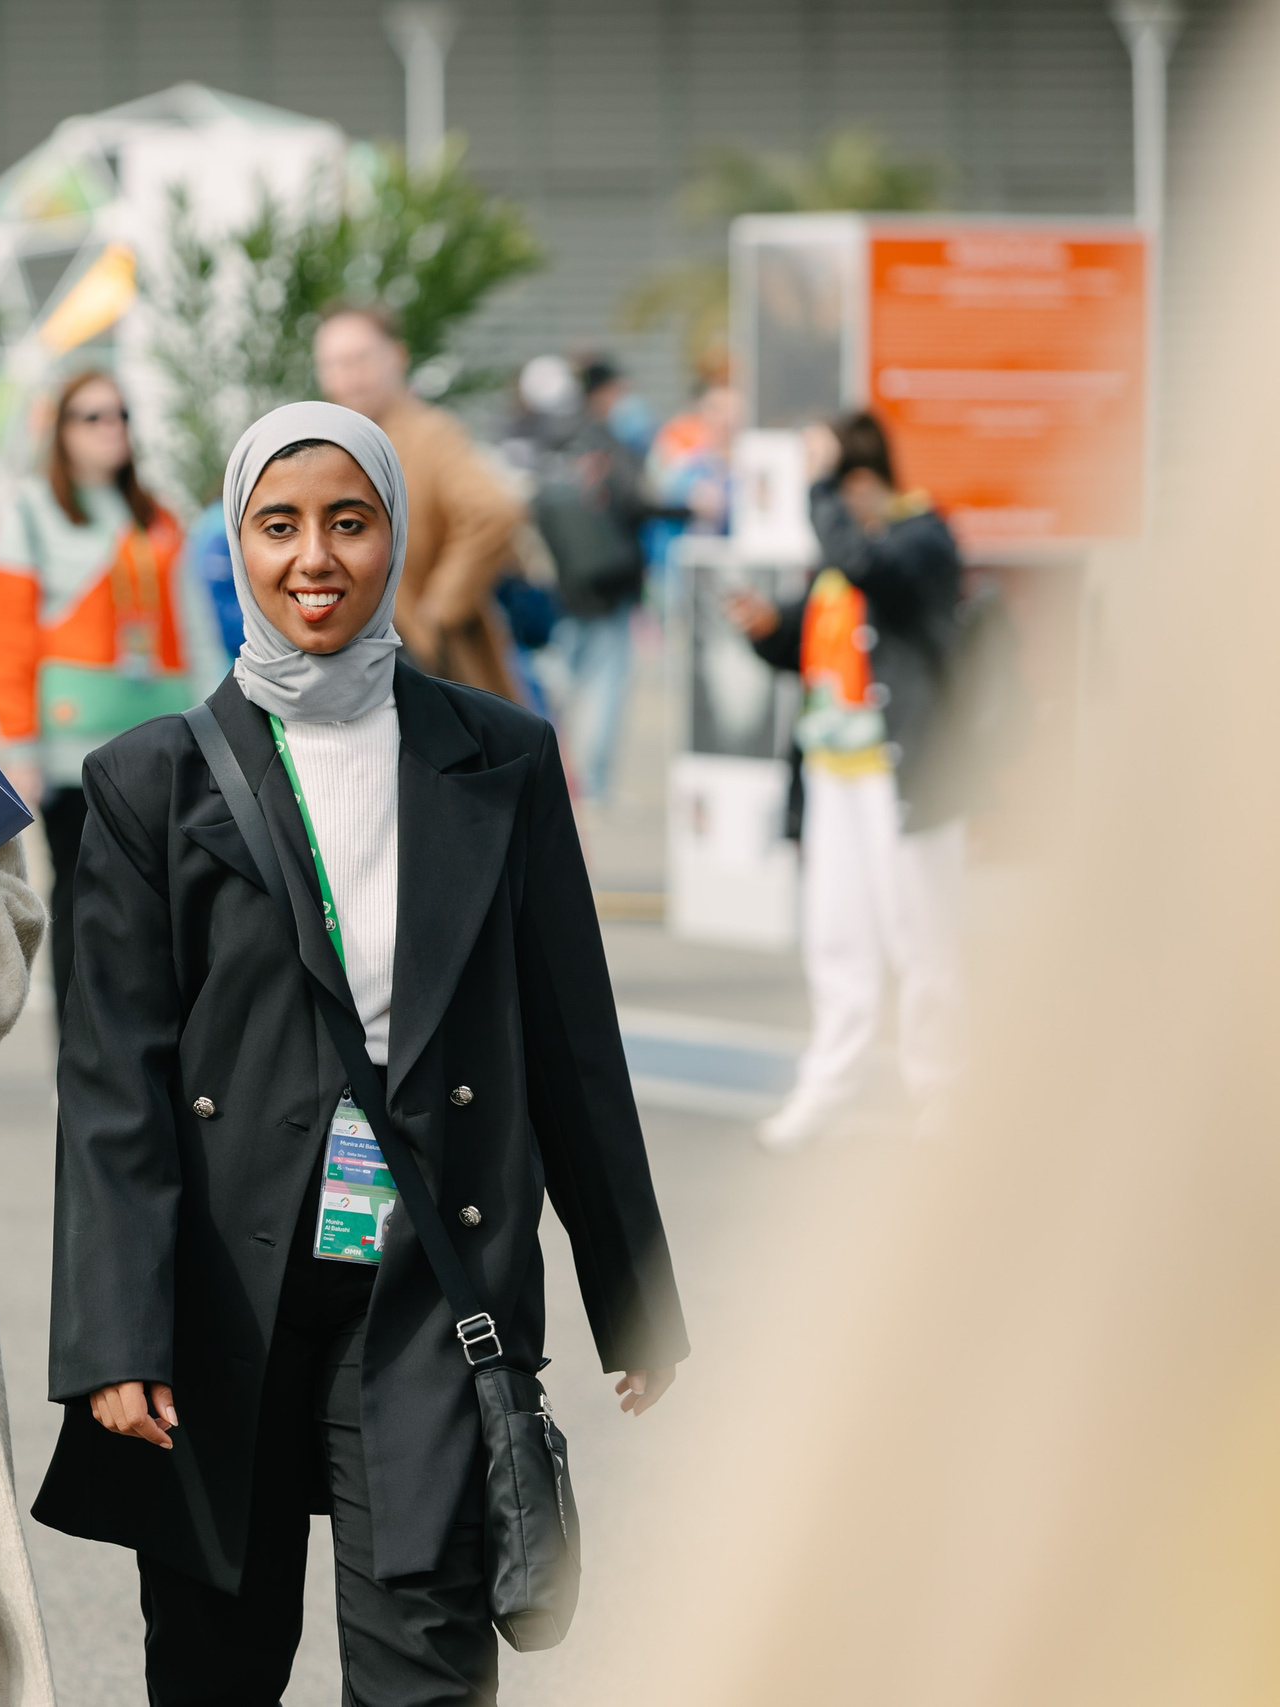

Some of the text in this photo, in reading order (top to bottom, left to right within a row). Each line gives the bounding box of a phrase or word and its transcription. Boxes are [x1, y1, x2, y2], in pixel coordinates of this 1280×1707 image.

[340, 1140, 358, 1148] Munira
[325, 1218, 343, 1226] Munira
[331, 1225, 350, 1233] Balushi
[344, 1248, 362, 1256] OMN
